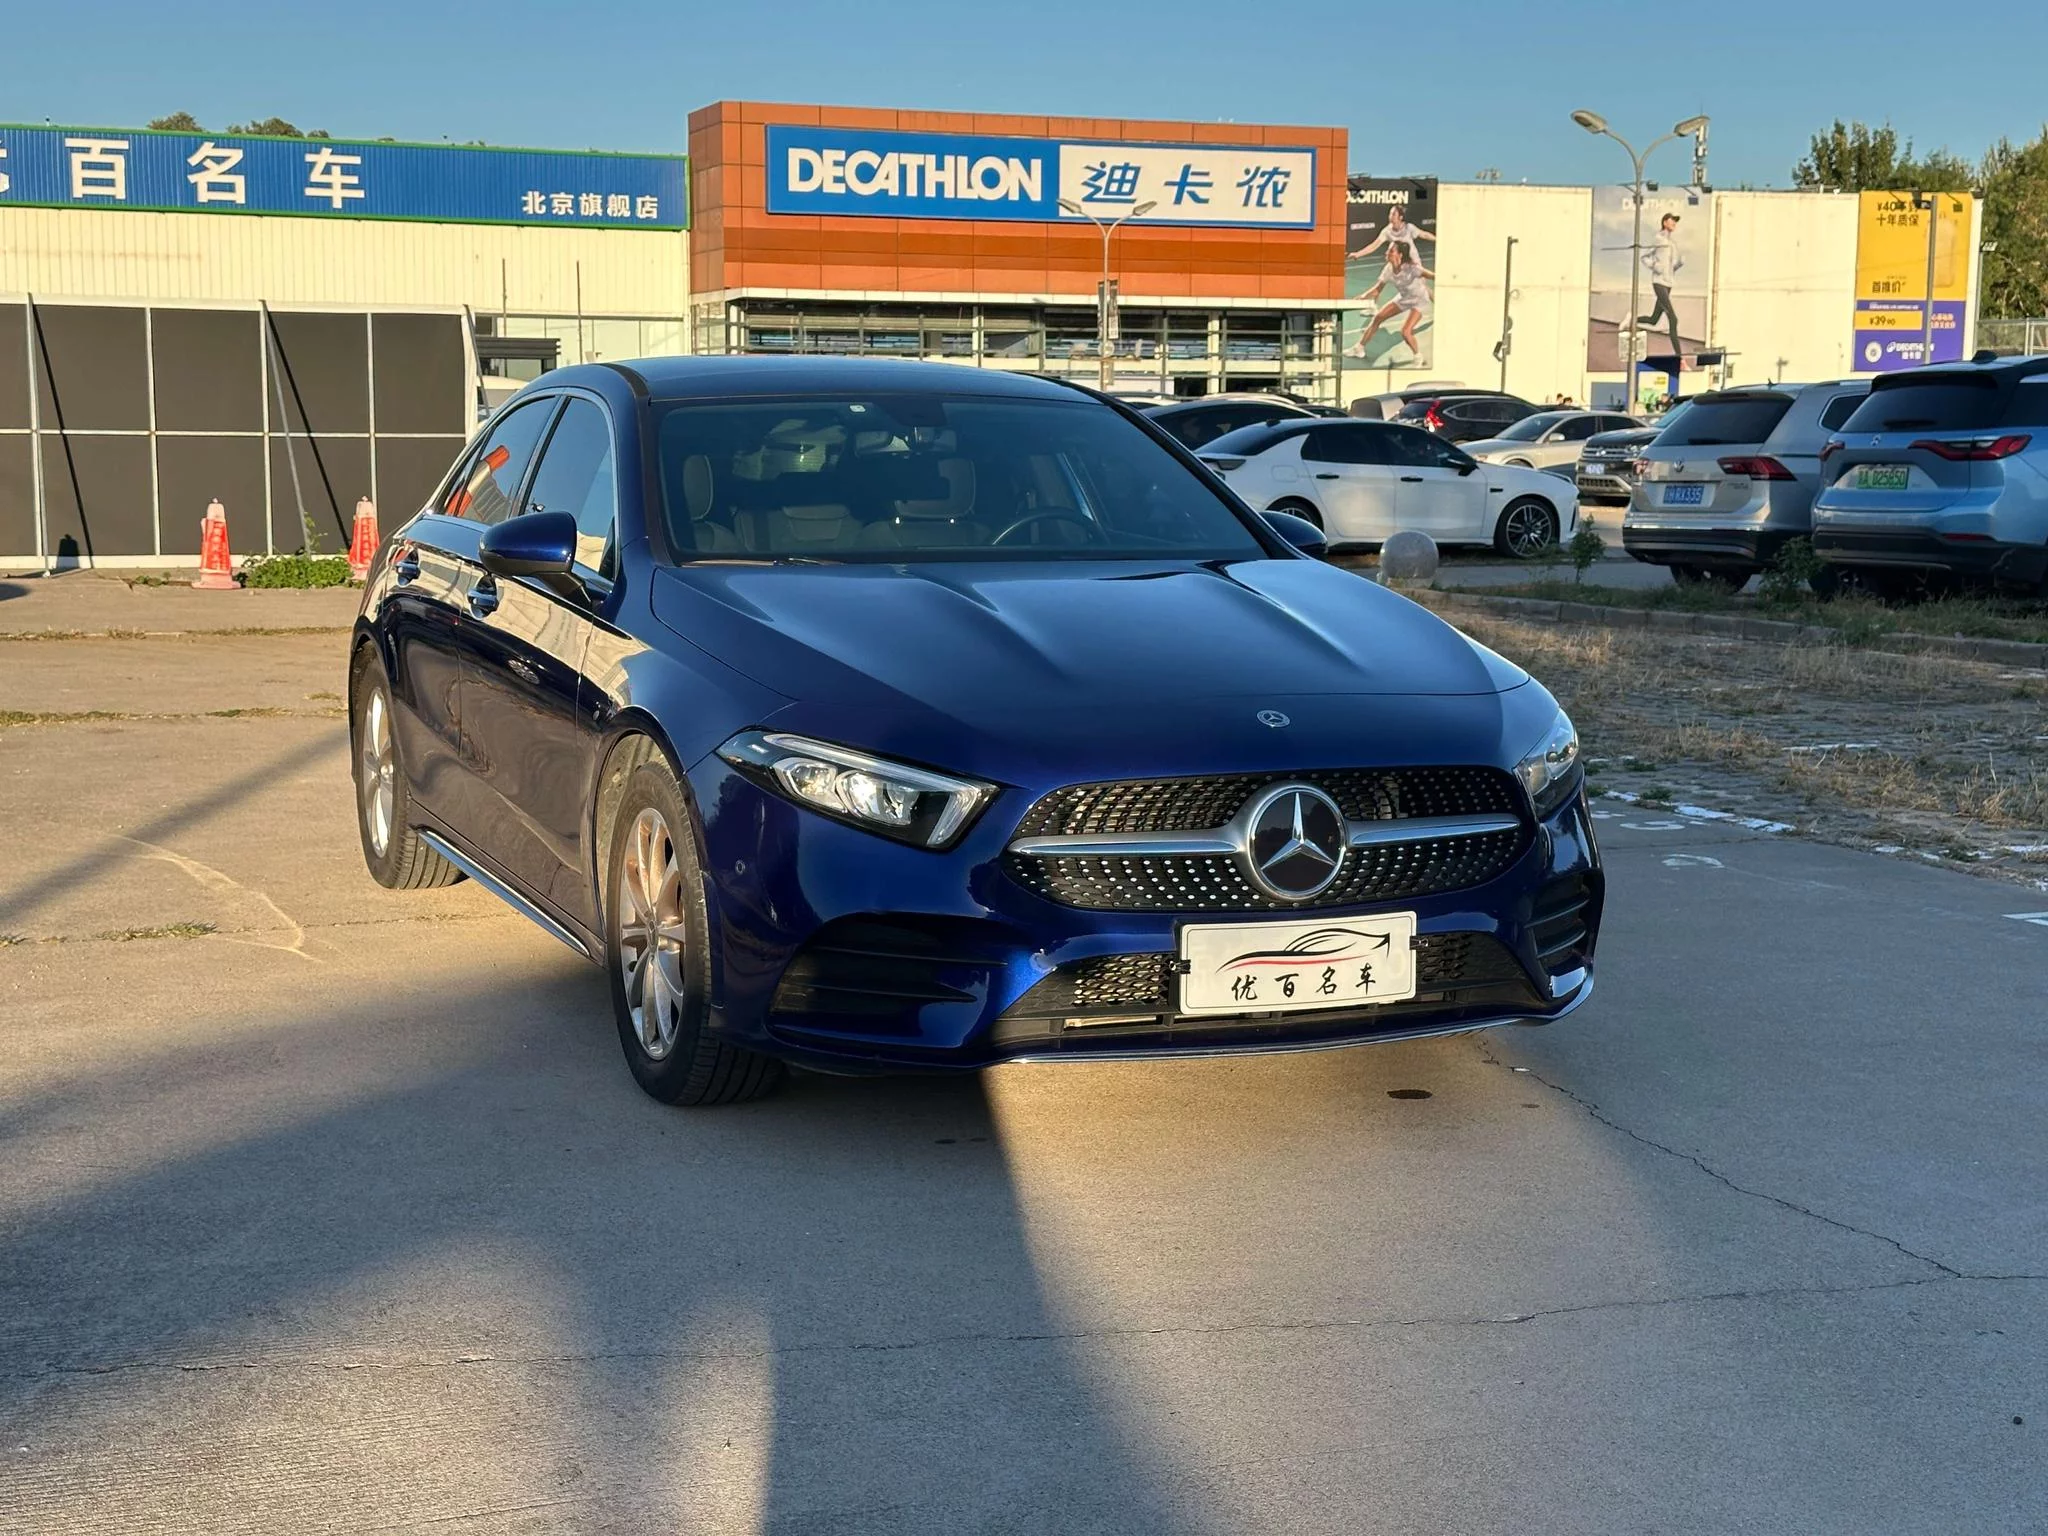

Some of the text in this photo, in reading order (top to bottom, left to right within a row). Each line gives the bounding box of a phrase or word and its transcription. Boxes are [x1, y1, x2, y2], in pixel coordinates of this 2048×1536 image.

[788, 147, 1042, 202] DECATHLON
[1081, 161, 1291, 208] 迪卡侬
[521, 191, 658, 218] 北京旗舰店
[1231, 962, 1376, 1001] 优百名车
